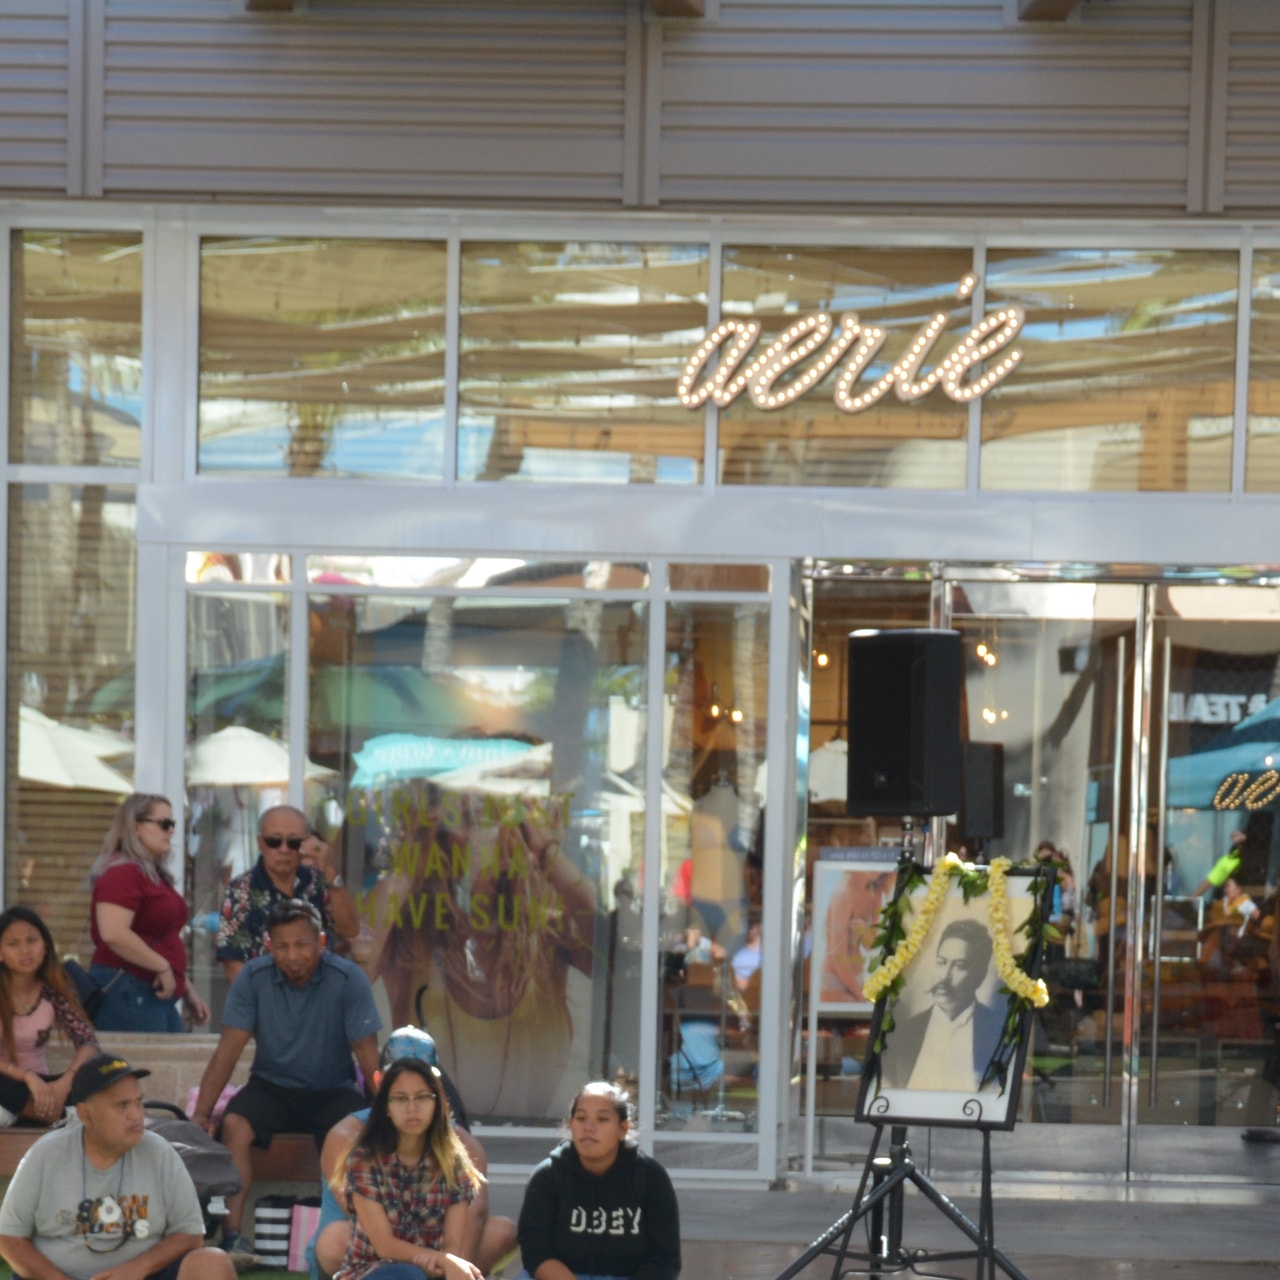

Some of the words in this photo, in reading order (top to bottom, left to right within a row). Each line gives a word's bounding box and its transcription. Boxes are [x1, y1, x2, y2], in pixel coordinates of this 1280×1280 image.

[677, 272, 1025, 413] aerie
[346, 789, 461, 827] GIRLS
[391, 842, 528, 880] WANNA
[355, 892, 450, 930] HAVE
[569, 1206, 642, 1235] OBEY
